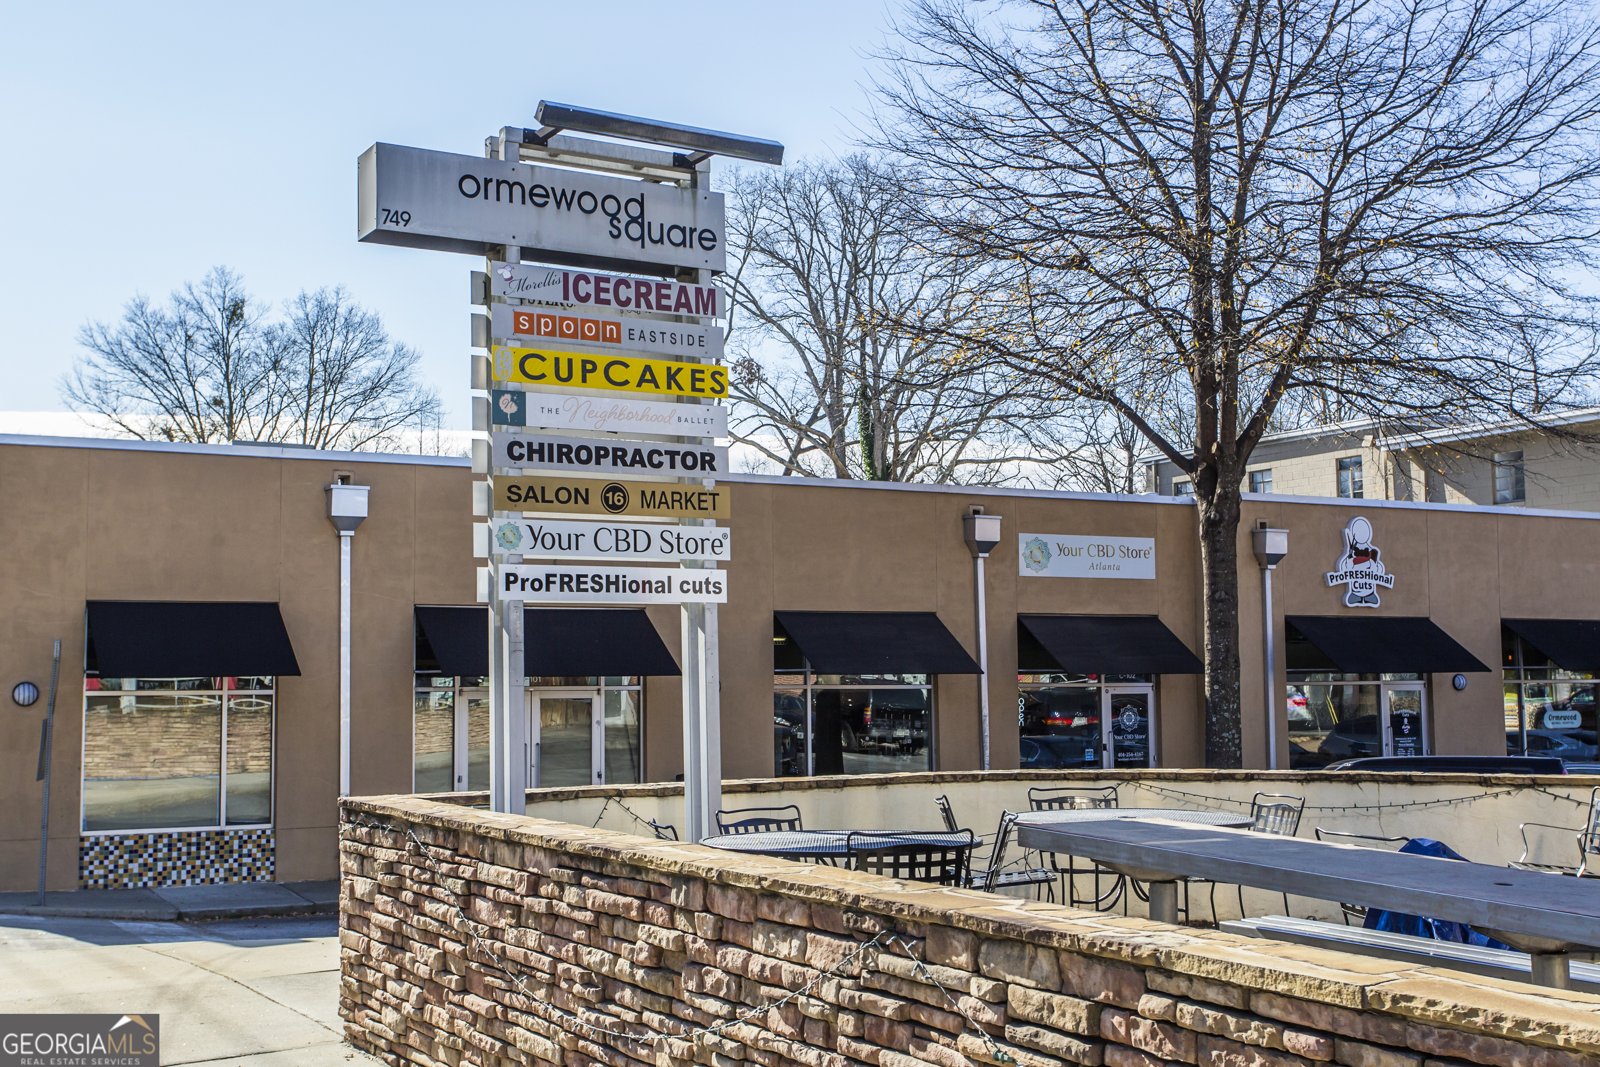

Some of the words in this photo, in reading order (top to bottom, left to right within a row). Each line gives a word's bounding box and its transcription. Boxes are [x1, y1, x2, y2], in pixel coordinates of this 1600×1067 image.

[458, 174, 645, 220] ormewood
[381, 208, 411, 227] 749
[609, 216, 717, 251] square
[503, 274, 562, 295] Morellis
[562, 272, 717, 316] ICECREAM
[518, 313, 617, 339] spoon
[628, 328, 705, 348] EASTSIDE
[518, 353, 726, 394] CUPCAKES
[540, 406, 560, 415] THE
[562, 397, 675, 429] Neighborhood
[677, 416, 714, 425] BALLET
[506, 440, 717, 471] CHIROPRACTOR
[506, 484, 590, 505] SALON
[603, 491, 625, 506] 16
[640, 490, 720, 511] MARKET
[525, 524, 585, 551] Your
[593, 527, 652, 553] CBD
[1056, 542, 1083, 557] Your
[1087, 543, 1115, 558] CBD
[1088, 562, 1121, 571] Atlanta
[1329, 570, 1393, 586] ProFRESHional
[504, 572, 672, 594] ProFRESHional
[679, 575, 723, 595] cuts
[1353, 580, 1373, 590] Cuts
